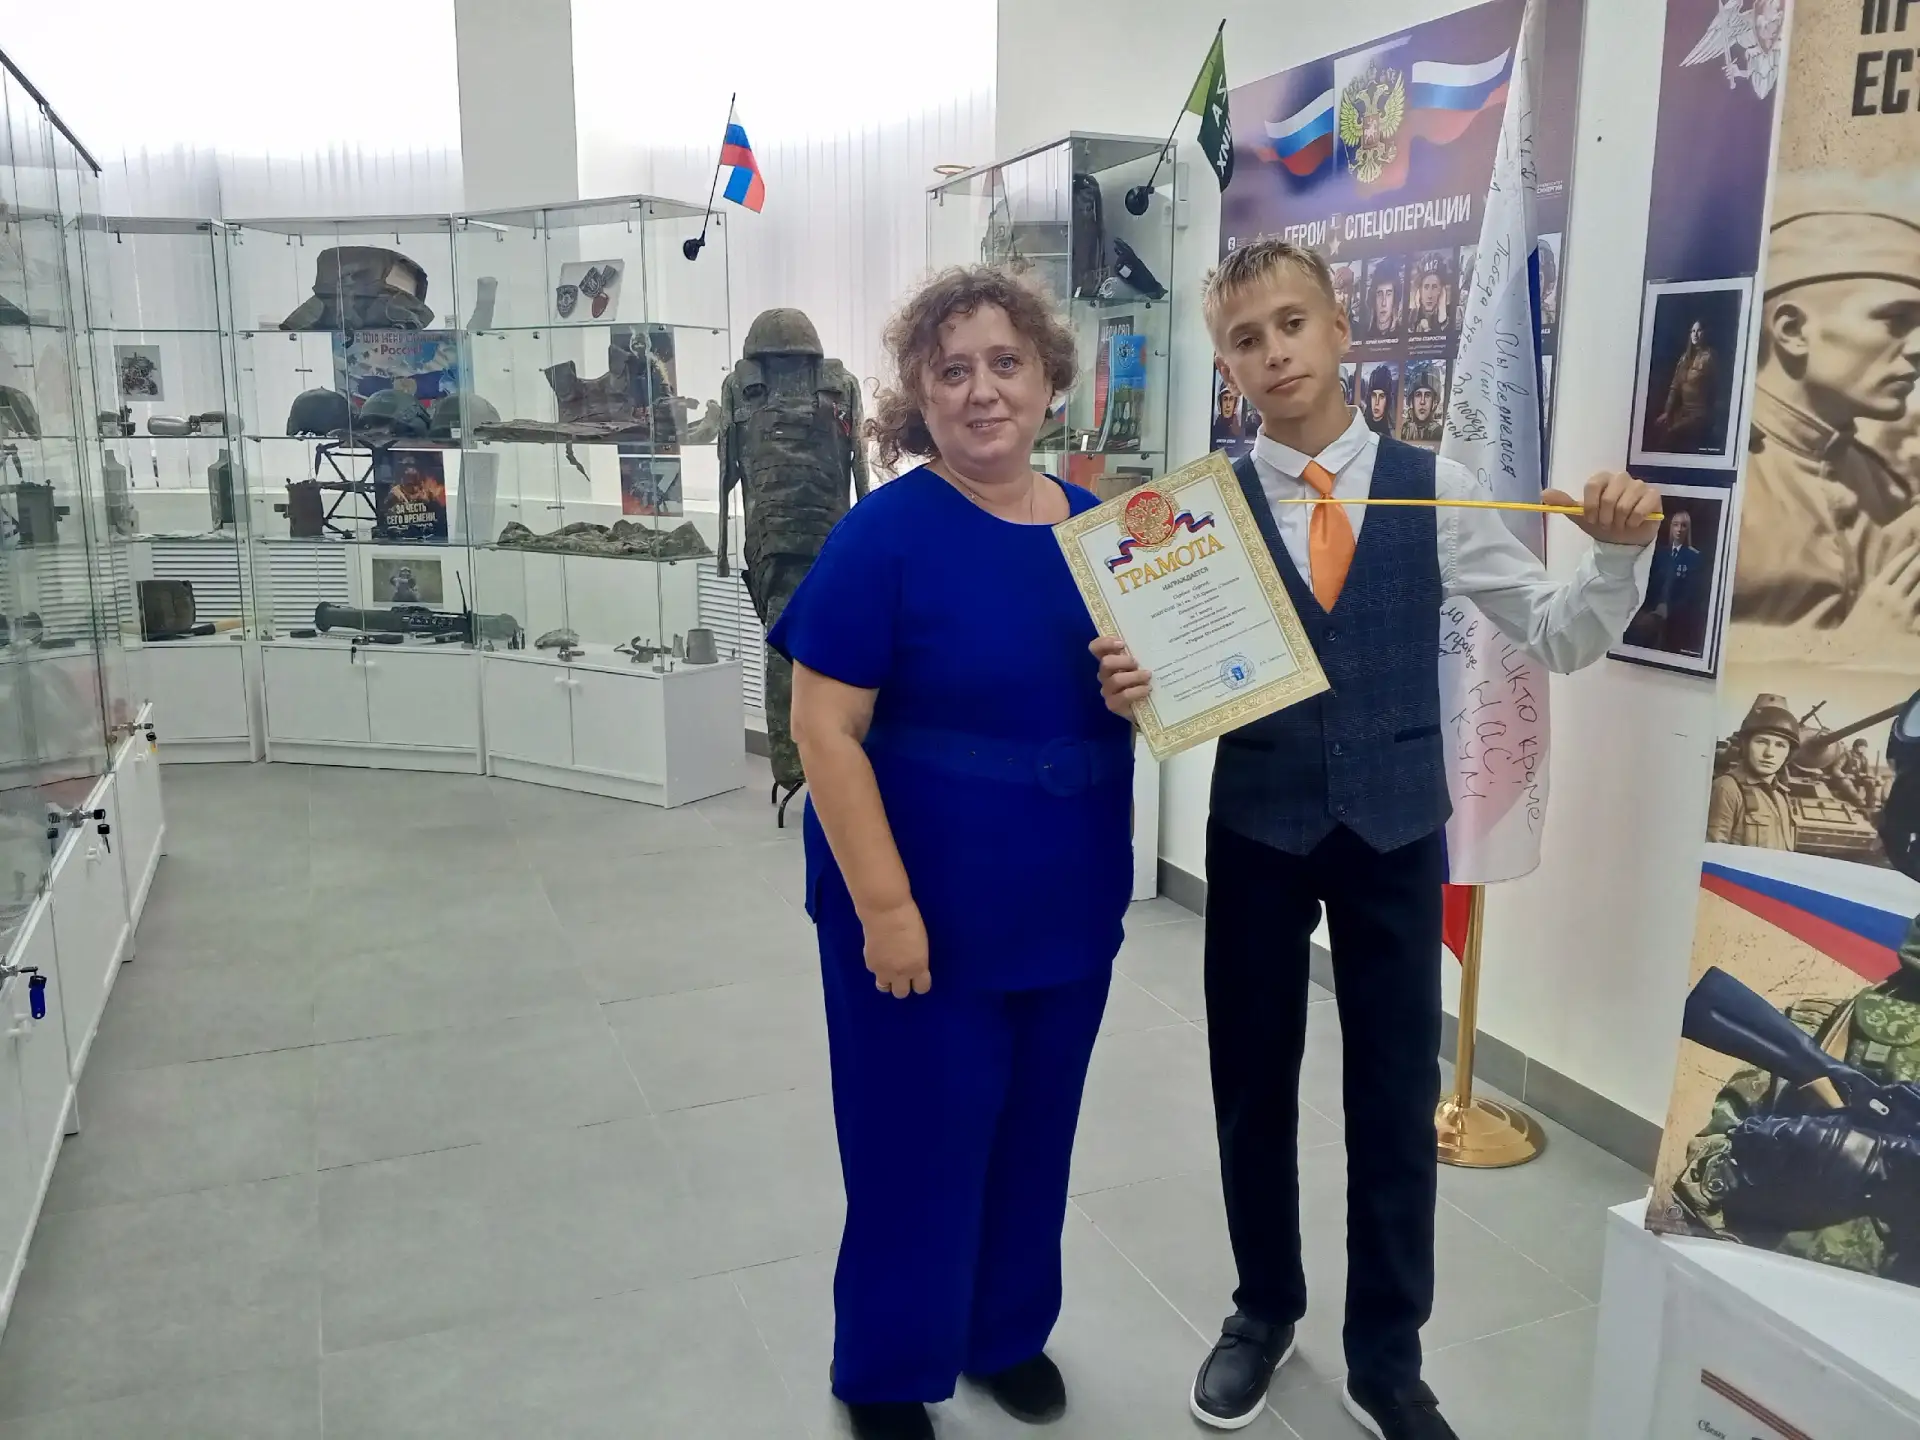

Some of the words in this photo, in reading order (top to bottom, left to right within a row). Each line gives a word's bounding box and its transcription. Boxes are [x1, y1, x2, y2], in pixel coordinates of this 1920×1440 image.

[1284, 220, 1327, 250] ГЕРОИ
[1344, 193, 1471, 241] СПЕЦОПЕРАЦИИ
[1114, 532, 1226, 595] ГРАМОТА
[1162, 566, 1209, 591] НАГРАЖДАЕТСЯ
